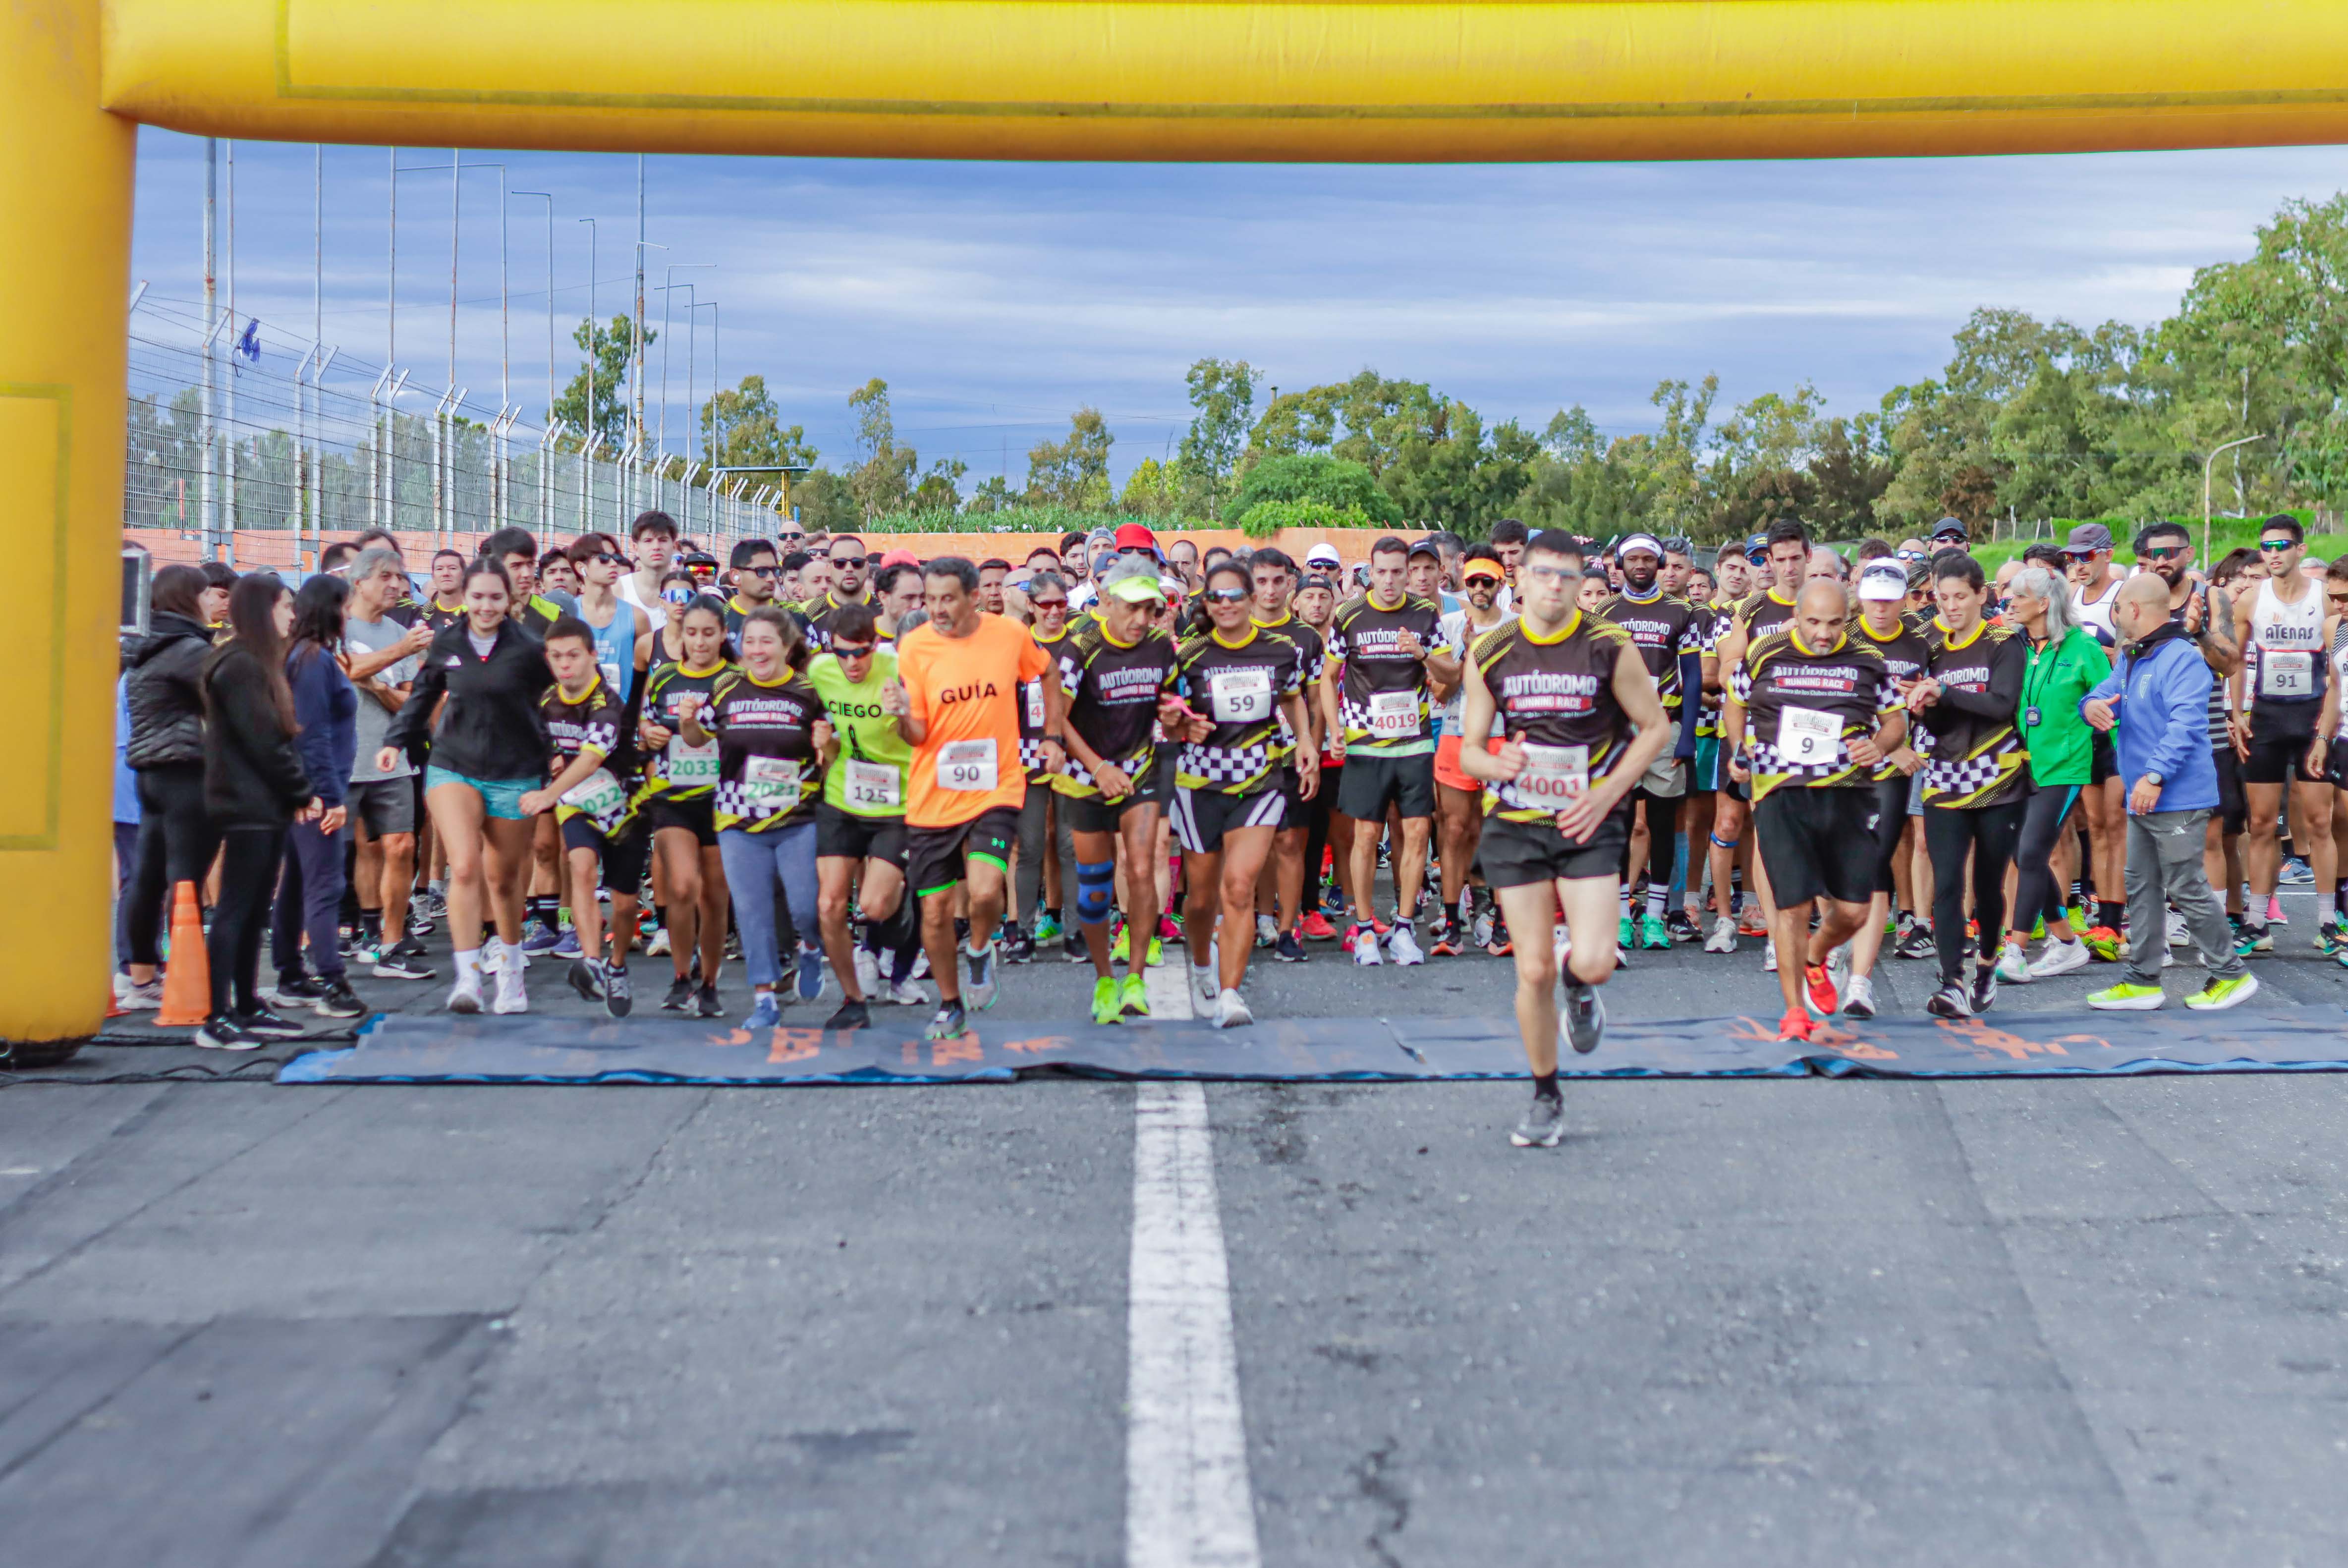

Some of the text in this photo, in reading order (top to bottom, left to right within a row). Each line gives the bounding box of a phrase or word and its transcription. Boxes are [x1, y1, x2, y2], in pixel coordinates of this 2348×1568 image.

[1356, 628, 1421, 646] AUTÓDRO
[2266, 624, 2314, 639] ATENAS
[1099, 667, 1163, 690] AUTÓDROMO
[1503, 669, 1597, 697] AUTÓDROMO
[1785, 677, 1845, 688] RUNNING RACE
[1937, 668, 1989, 685] TÓDROMO
[2276, 674, 2297, 687] 91
[942, 679, 997, 704] GUÍA
[728, 698, 803, 717] AUTÓDROMO
[829, 700, 882, 718] CIEGO
[1230, 695, 1254, 712] 59
[1375, 714, 1417, 730] 4019
[1801, 737, 1814, 754] 9
[672, 759, 721, 776] 2033
[953, 766, 980, 782] 90
[855, 785, 889, 803] 125
[1519, 774, 1580, 799] 4001
